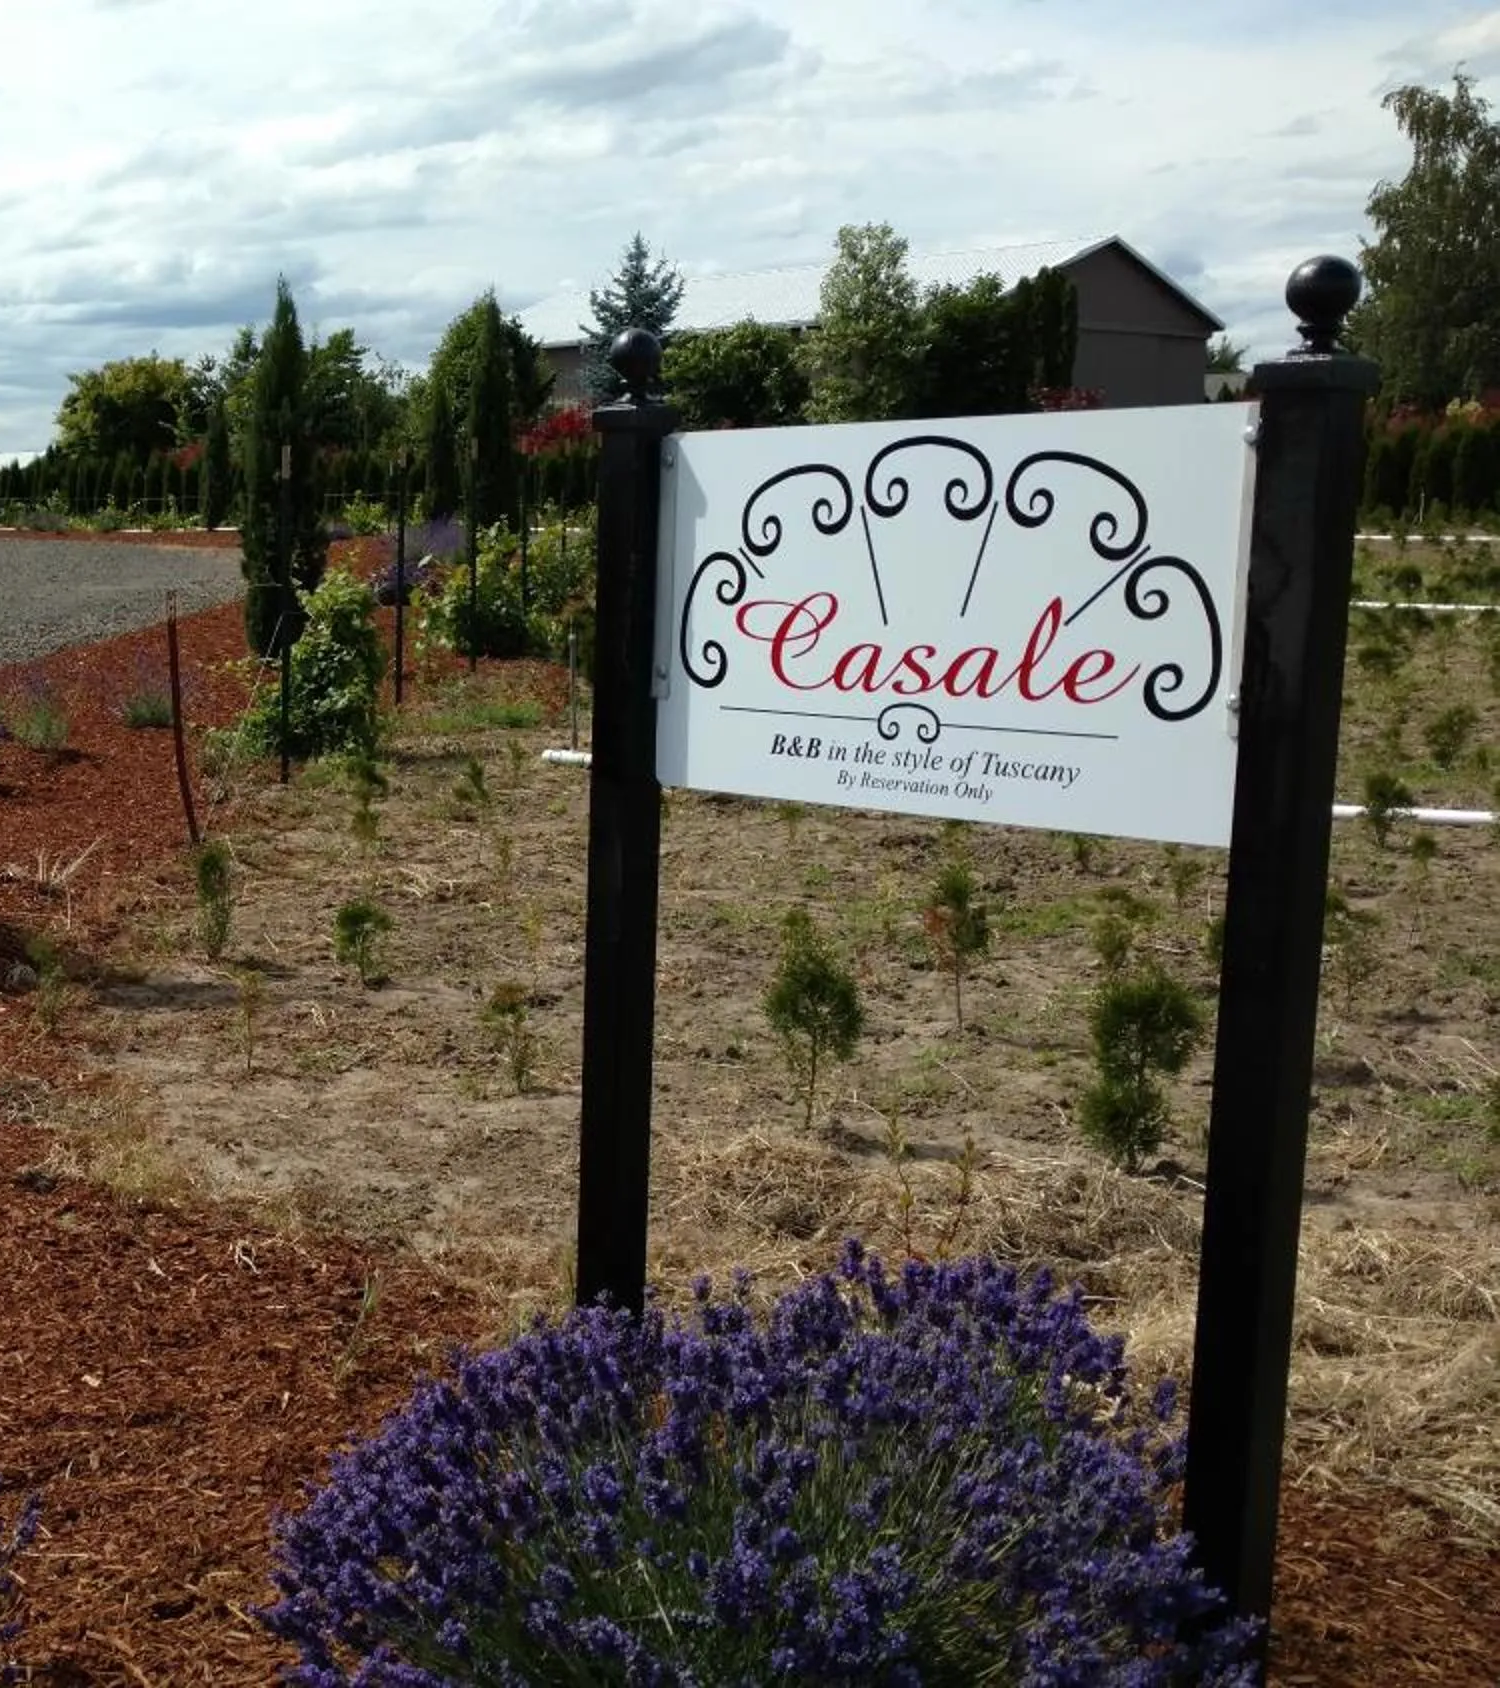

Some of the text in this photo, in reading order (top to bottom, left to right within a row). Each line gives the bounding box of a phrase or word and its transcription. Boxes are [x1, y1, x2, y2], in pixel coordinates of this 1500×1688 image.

[735, 592, 1141, 704] Casale
[771, 733, 1081, 789] B&B in the style of Tuscany
[837, 770, 994, 804] By Reservation Only
